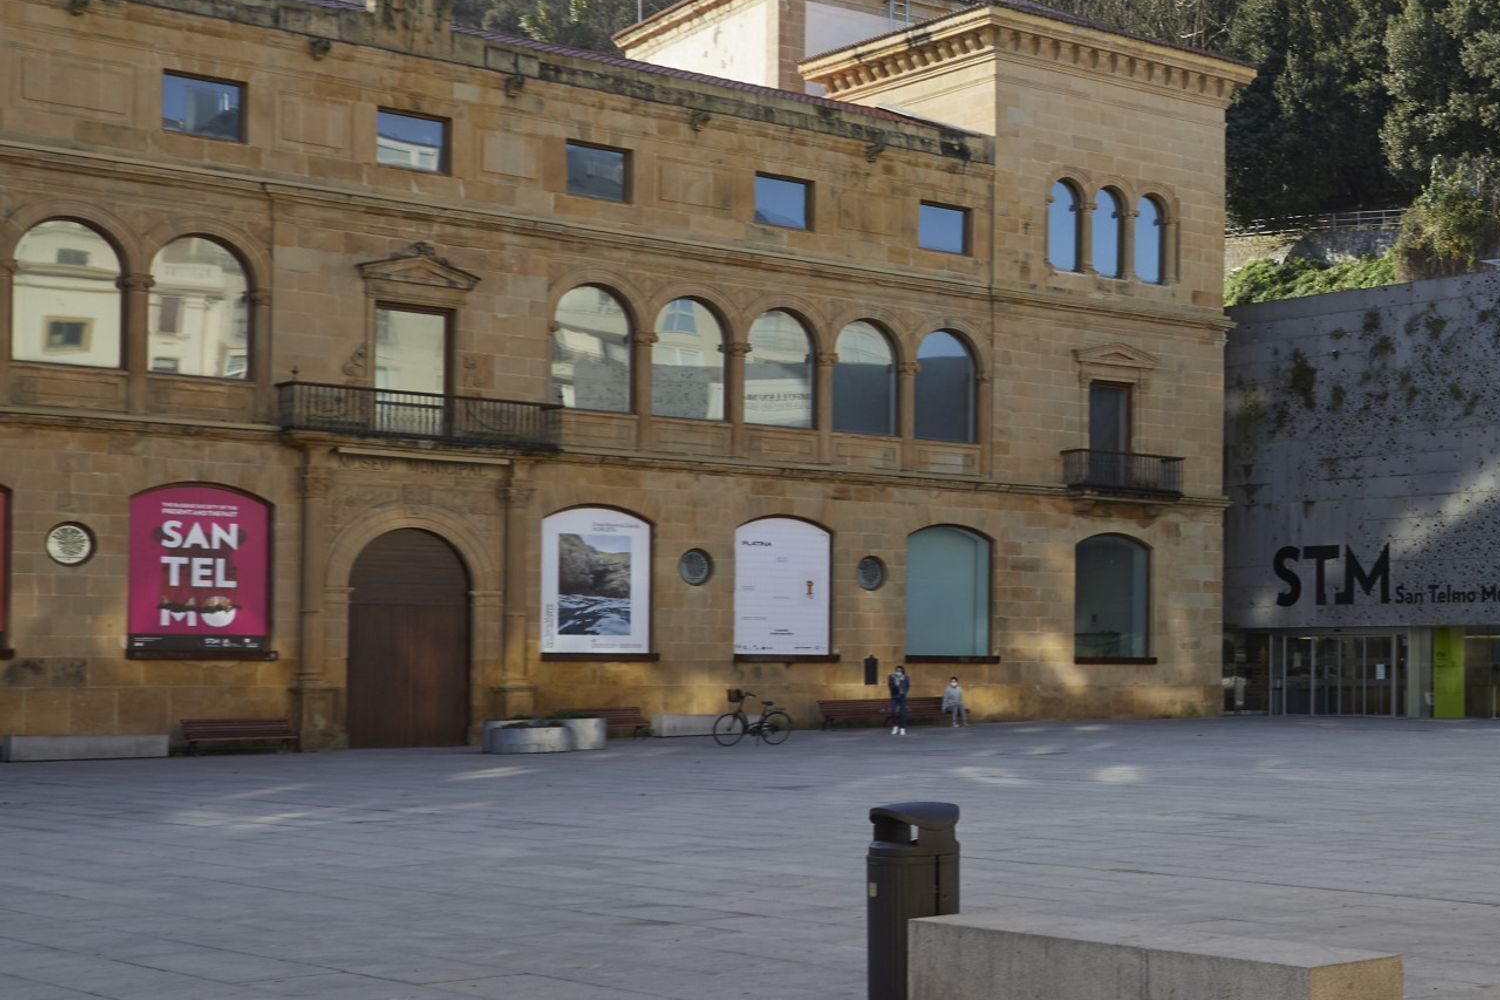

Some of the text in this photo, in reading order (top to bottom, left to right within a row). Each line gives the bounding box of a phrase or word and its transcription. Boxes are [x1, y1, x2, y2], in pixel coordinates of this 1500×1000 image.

[161, 520, 239, 550] SAN
[160, 556, 237, 588] TEL
[1273, 542, 1390, 607] STM
[1395, 585, 1423, 604] San
[1429, 585, 1476, 603] Telmo
[160, 596, 237, 627] MO
